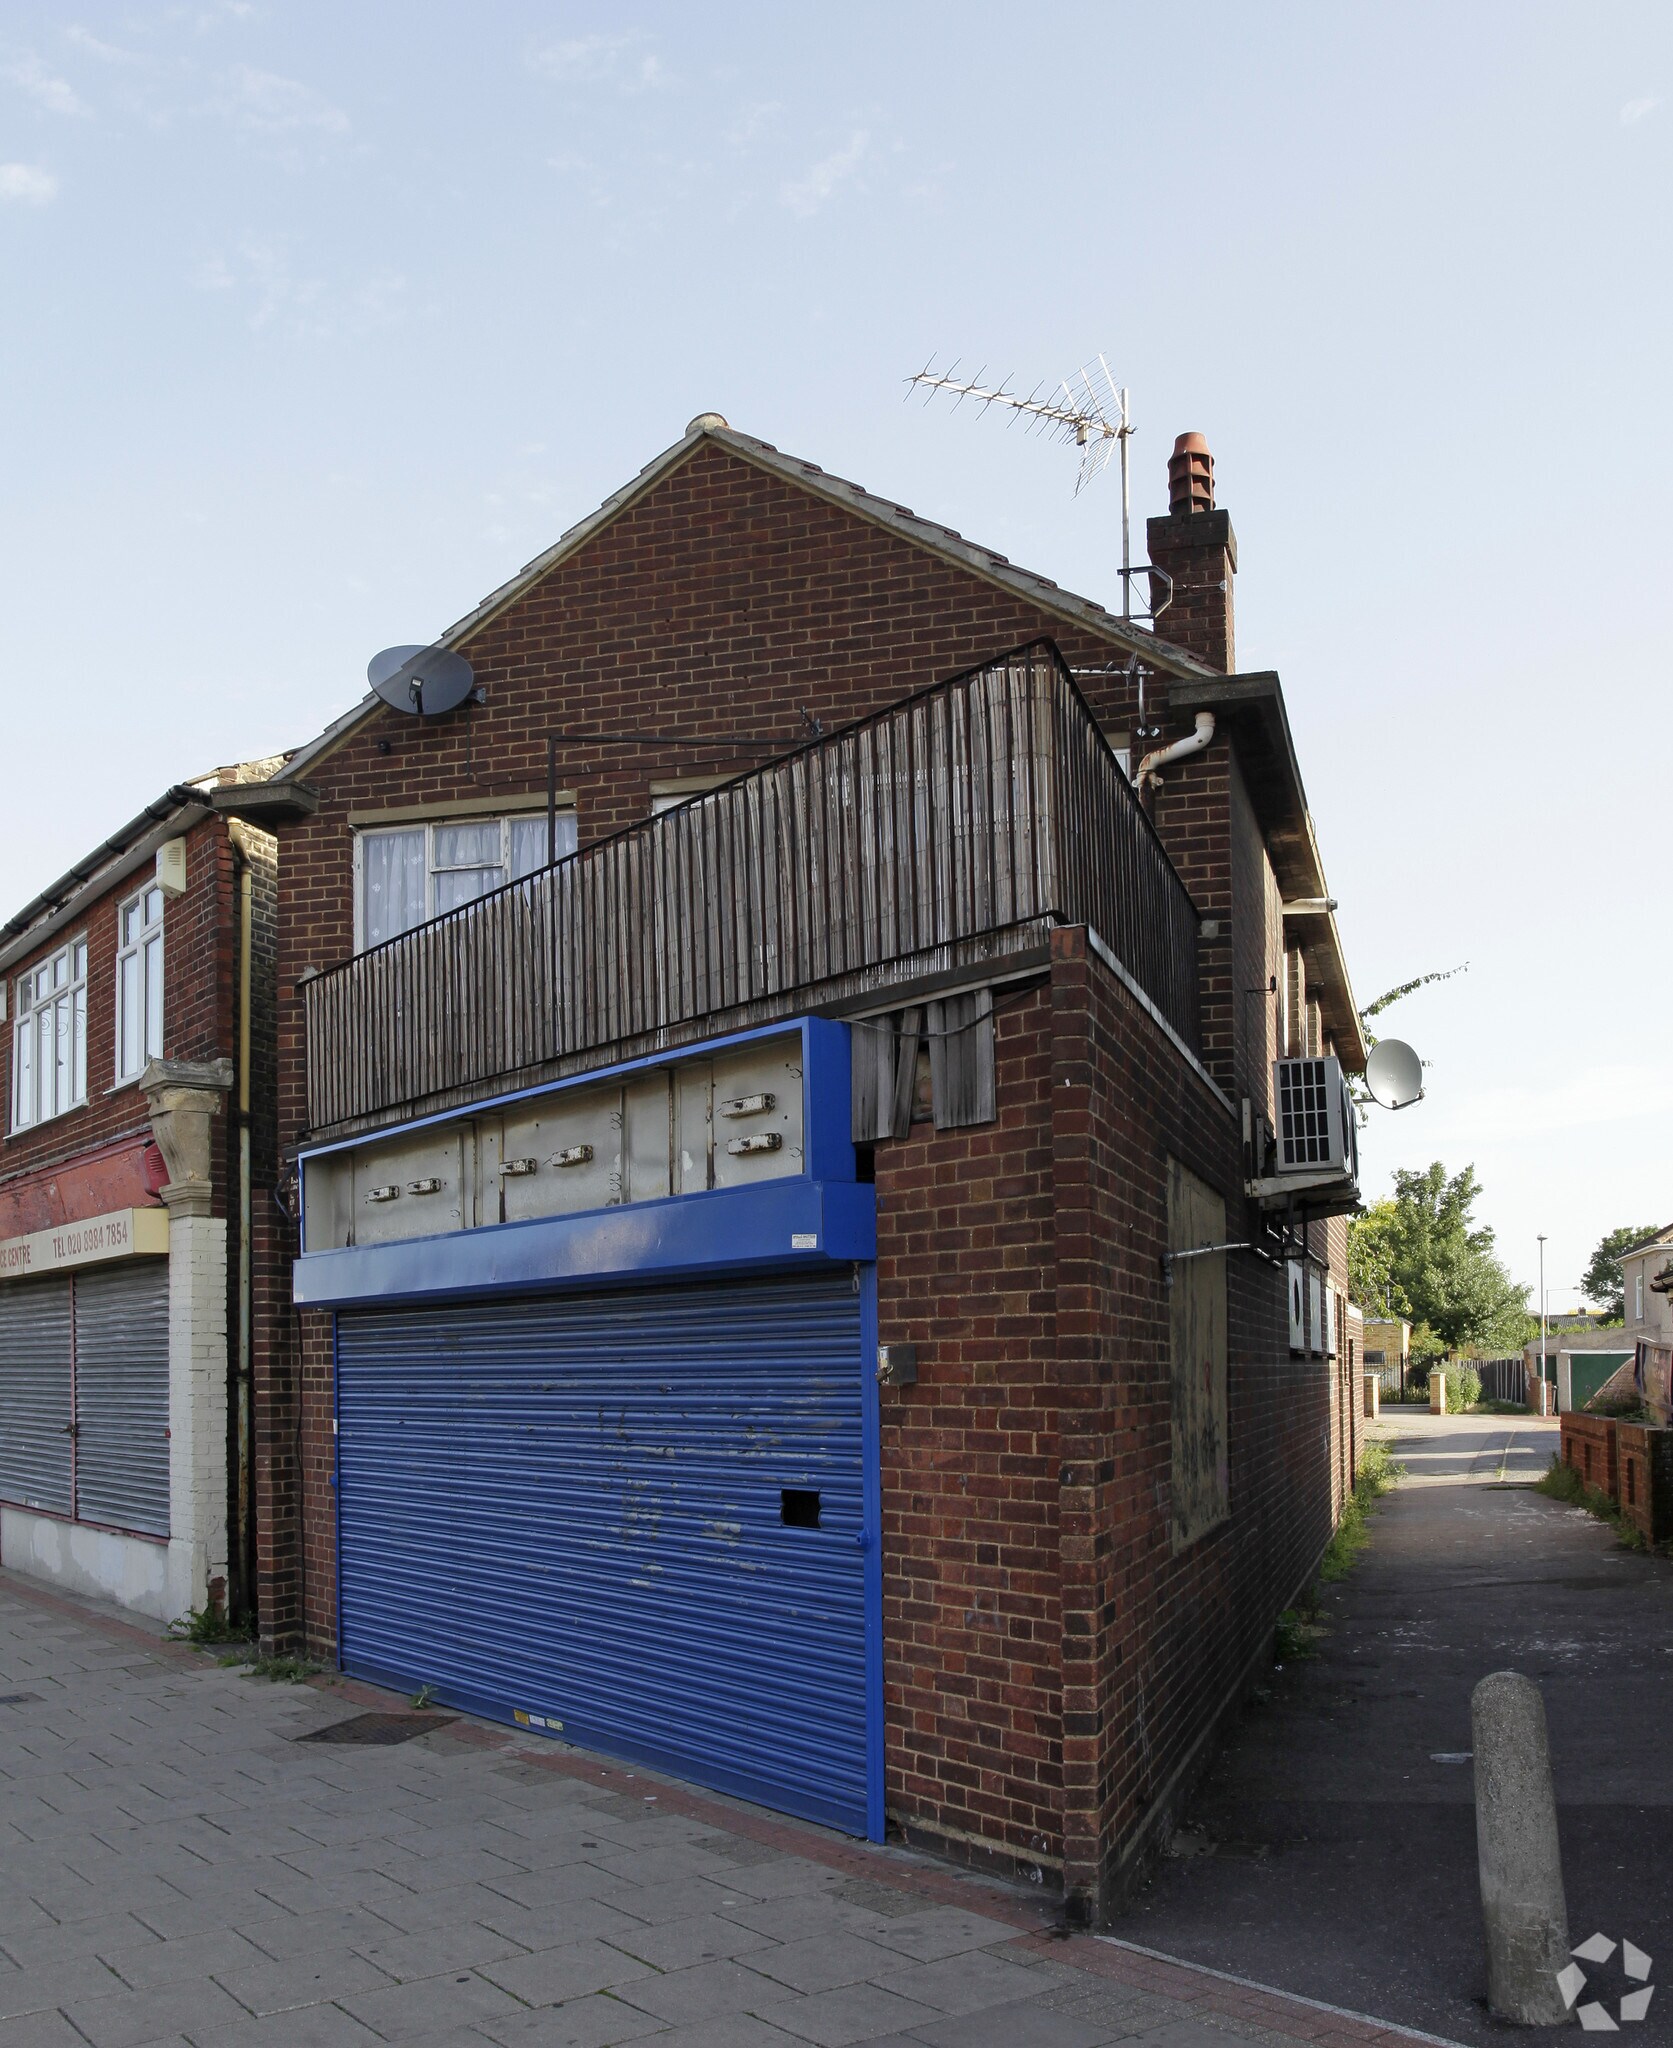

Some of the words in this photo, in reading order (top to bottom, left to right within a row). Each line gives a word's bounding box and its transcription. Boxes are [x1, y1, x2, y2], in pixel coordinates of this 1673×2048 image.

[8, 1244, 31, 1267] CENTRE
[53, 1236, 65, 1259] TEL
[67, 1232, 82, 1255] 020
[83, 1226, 104, 1252] 8984
[106, 1220, 128, 1247] 7854
